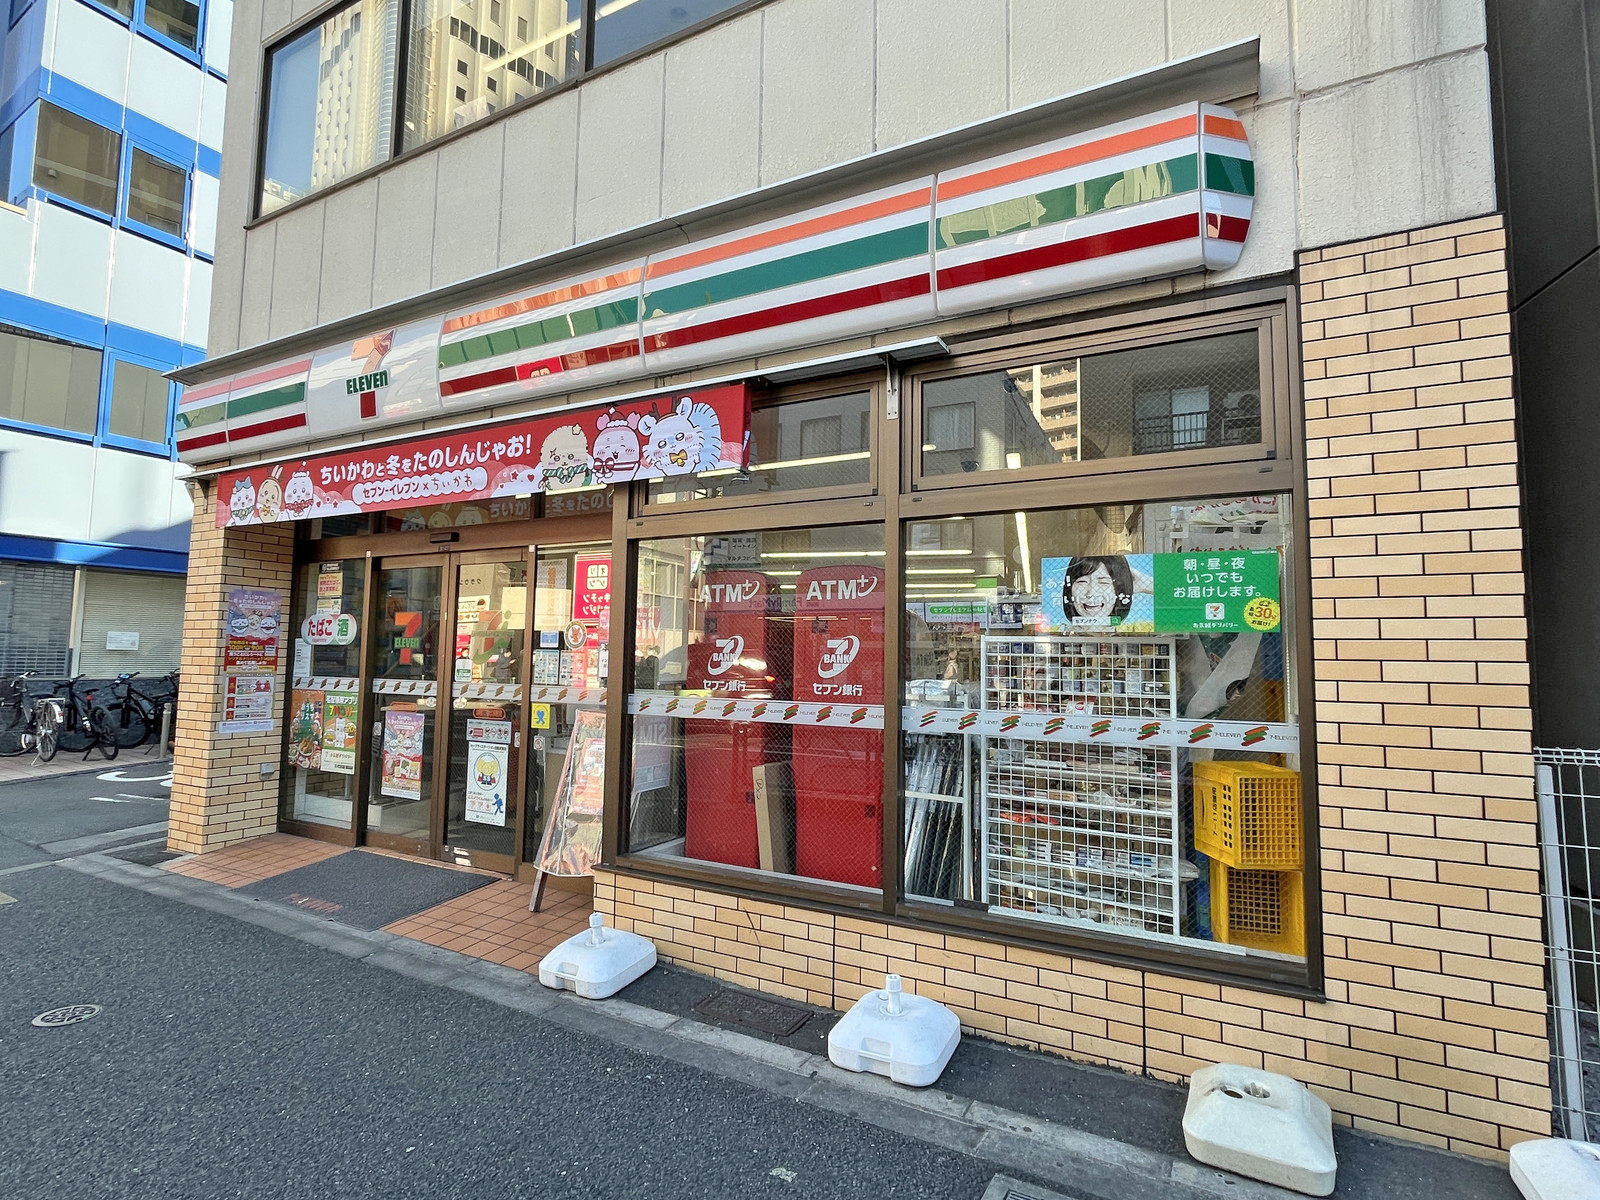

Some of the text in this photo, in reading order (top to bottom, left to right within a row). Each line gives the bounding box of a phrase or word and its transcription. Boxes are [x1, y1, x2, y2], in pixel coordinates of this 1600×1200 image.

[431, 472, 473, 491] ちいかわ
[1183, 557, 1246, 571] 朝・昼・夜
[1186, 571, 1243, 584] いつでも
[1173, 585, 1262, 598] お届けします。
[308, 618, 349, 637] たばこ 酒
[712, 653, 737, 662] BANK
[823, 654, 850, 664] BANK
[703, 680, 747, 692] セブン銀行
[812, 682, 863, 696] セブン銀行
